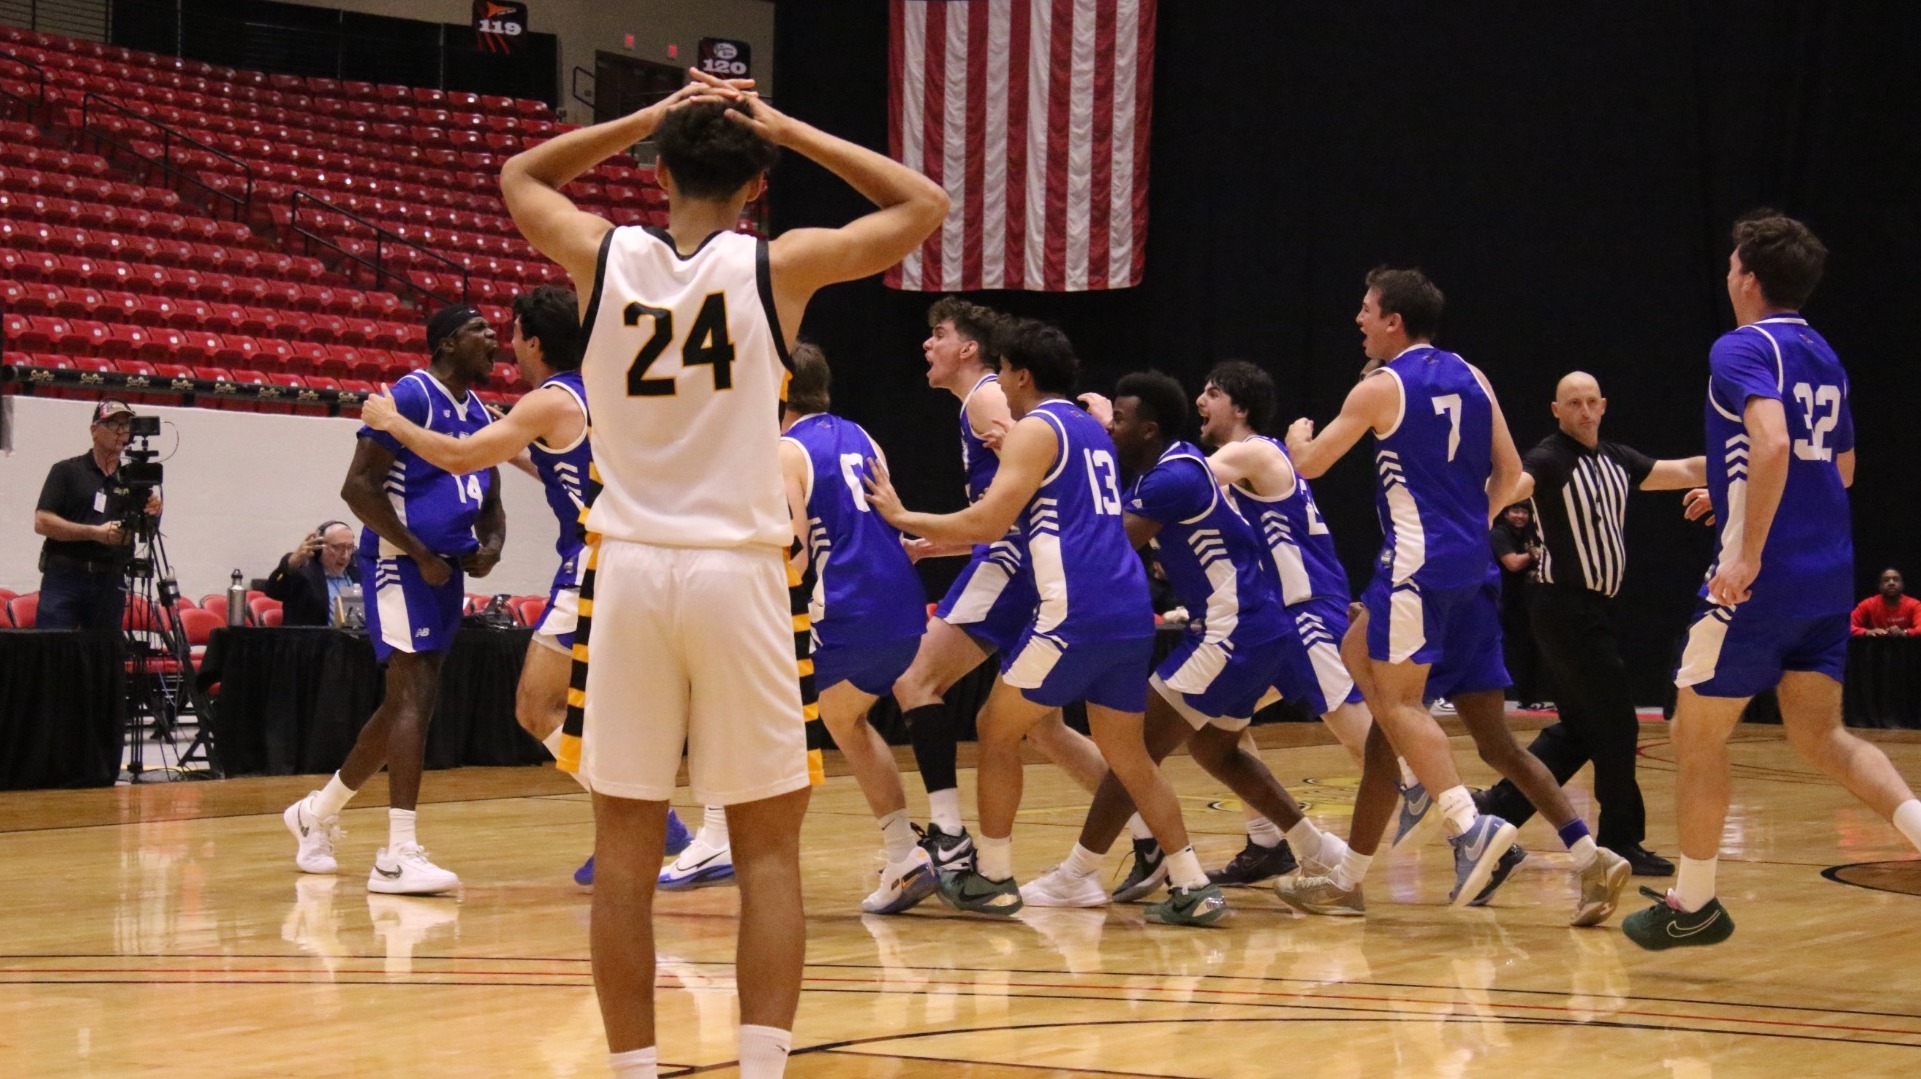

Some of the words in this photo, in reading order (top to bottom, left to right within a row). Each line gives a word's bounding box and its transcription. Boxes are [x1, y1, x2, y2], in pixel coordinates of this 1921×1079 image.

[479, 19, 522, 36] 119
[703, 58, 747, 75] 120
[622, 289, 736, 398] 24
[1432, 393, 1463, 463] 7
[1793, 382, 1841, 463] 32
[451, 473, 484, 511] 14
[1083, 448, 1121, 516] 13
